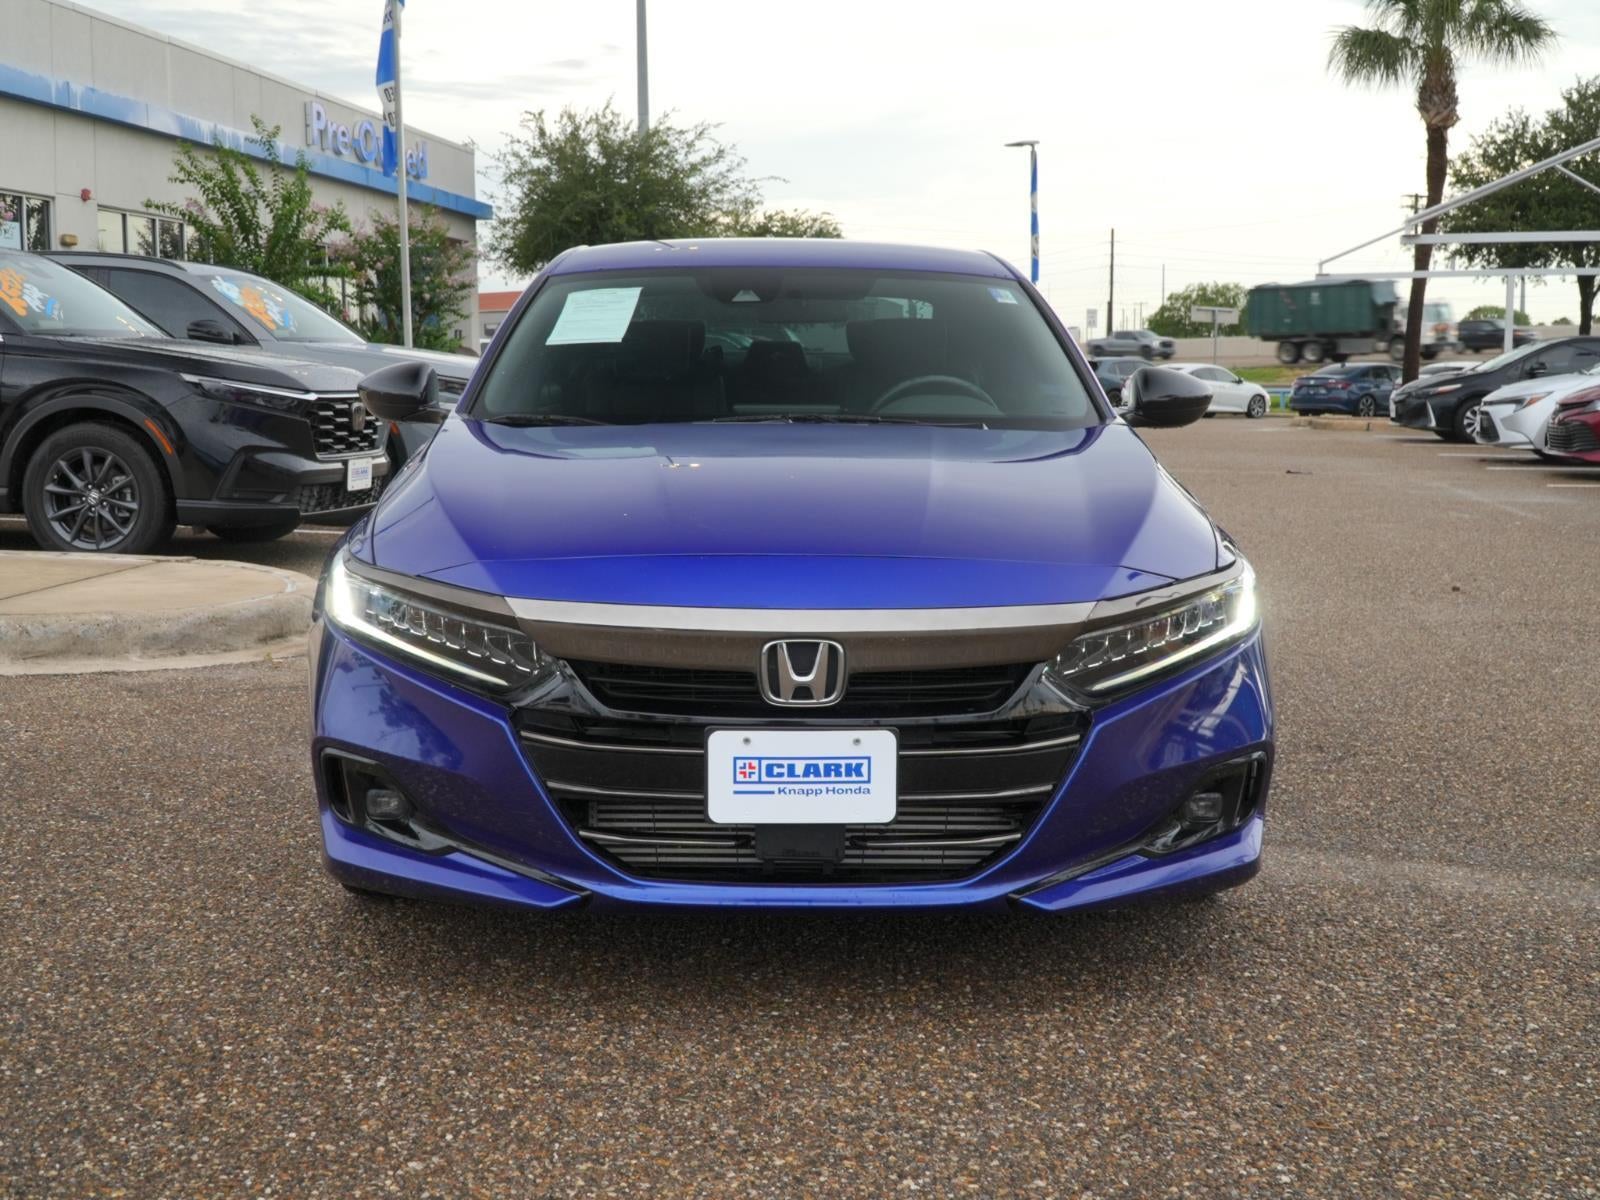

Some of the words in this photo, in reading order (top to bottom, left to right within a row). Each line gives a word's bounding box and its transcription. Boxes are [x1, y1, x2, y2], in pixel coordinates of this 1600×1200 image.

[304, 101, 428, 178] Pre-Oed
[765, 762, 864, 778] CLARK
[777, 786, 823, 797] Knapp
[825, 786, 871, 795] Honda
